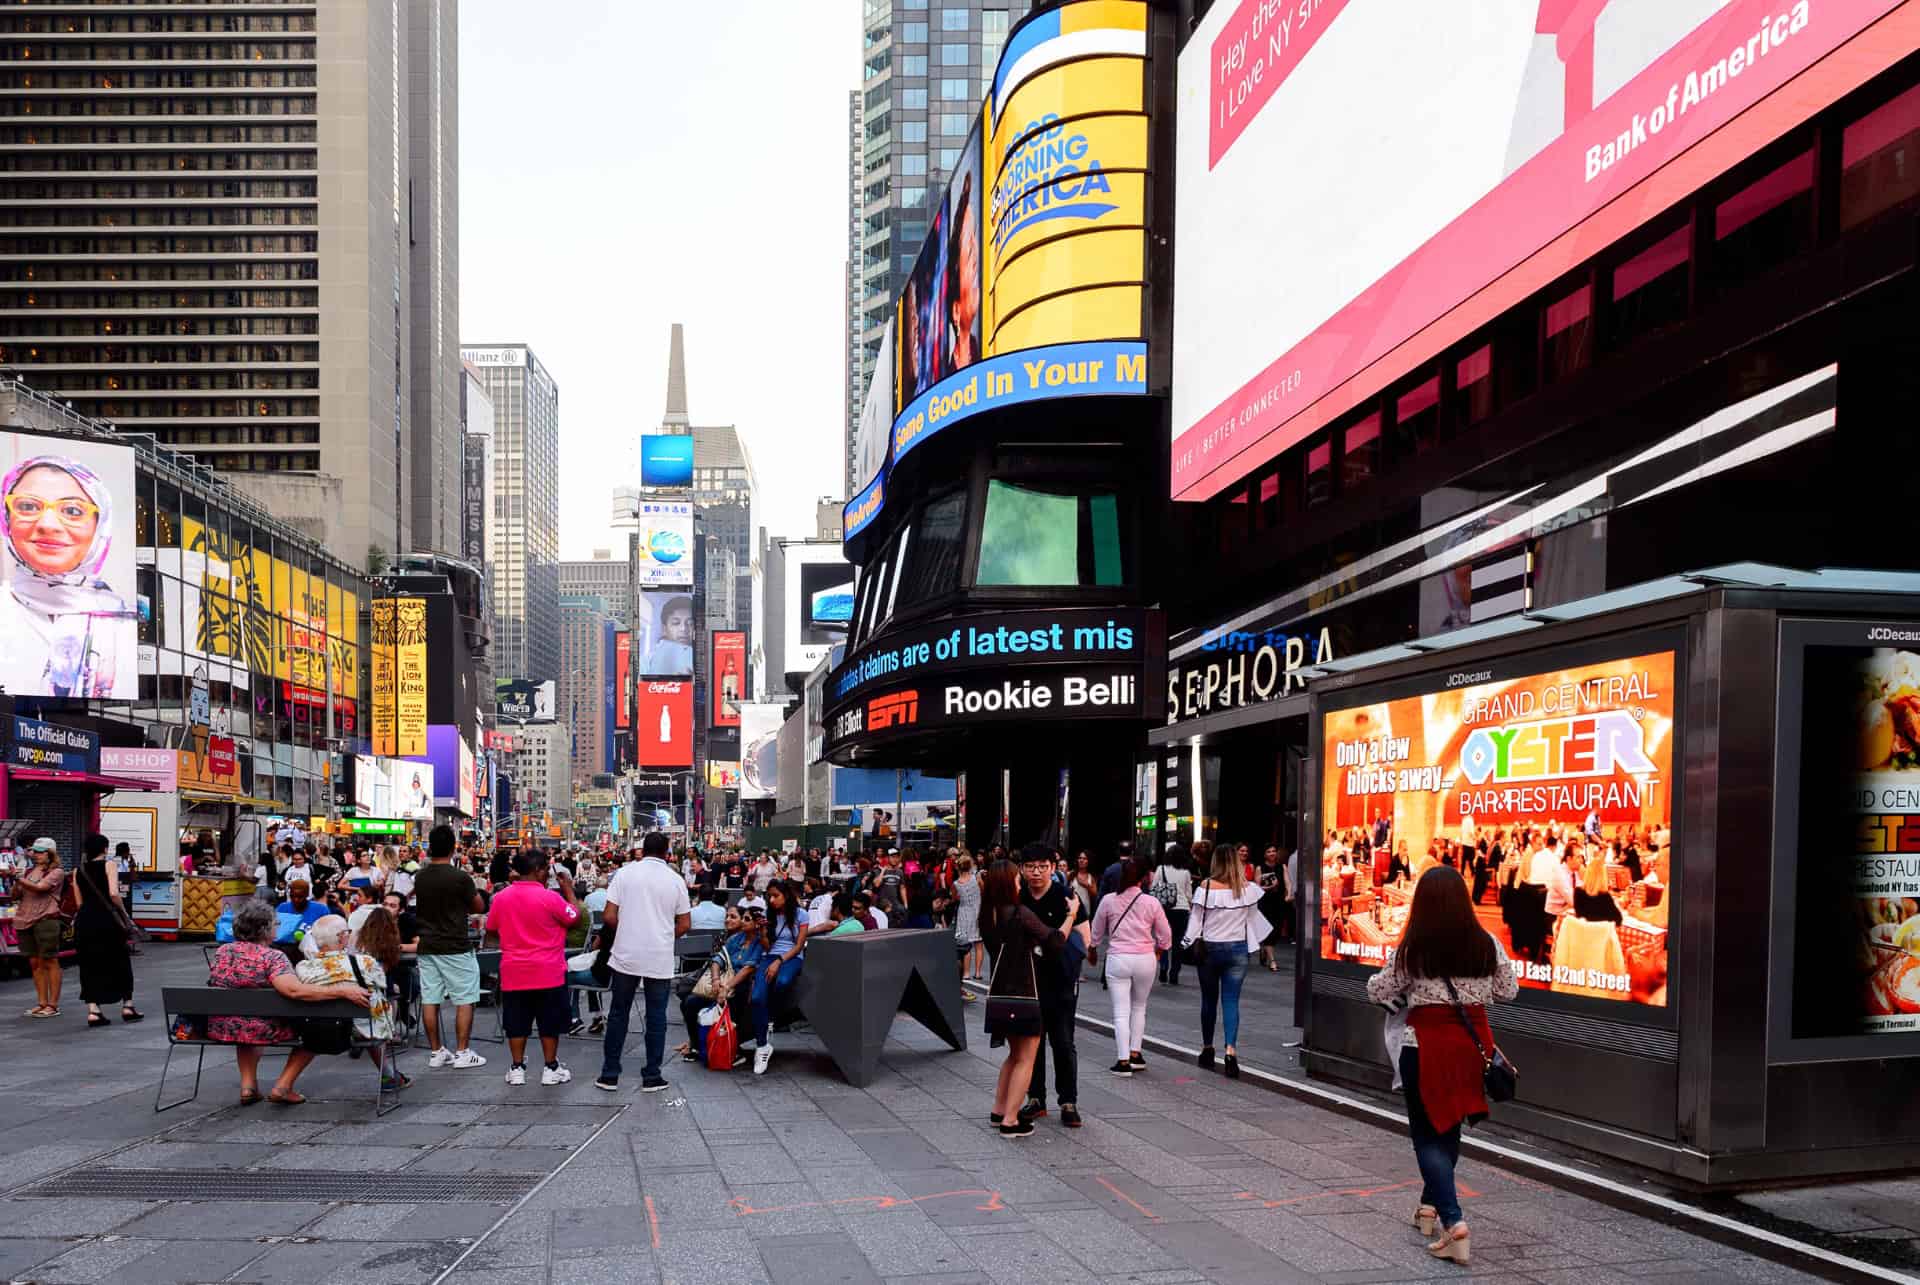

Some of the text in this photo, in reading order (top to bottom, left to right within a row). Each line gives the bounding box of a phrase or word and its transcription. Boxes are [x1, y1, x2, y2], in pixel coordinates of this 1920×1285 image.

[1219, 32, 1248, 86] Hey
[1219, 100, 1225, 129] I
[1229, 58, 1264, 118] Love
[1268, 8, 1294, 67] NY
[1585, 0, 1809, 183] Bank of America
[928, 376, 978, 423] Good
[986, 370, 1014, 399] In
[1023, 359, 1104, 389] Your
[1176, 448, 1194, 474] LIFE
[1201, 416, 1237, 455] BETTER
[1239, 369, 1303, 428] CONNECTED
[471, 456, 487, 532] TIMES
[302, 592, 326, 617] THE
[865, 650, 899, 681] claims
[902, 641, 930, 669] are
[936, 629, 960, 660] of
[968, 622, 1064, 657] latest
[1073, 620, 1133, 651] mis
[400, 681, 424, 694] KING
[402, 670, 422, 681] LION
[1166, 626, 1333, 726] SEPHORA
[1446, 670, 1492, 687] JCDecaux
[867, 690, 919, 731] ESPN
[945, 675, 1135, 715] Rookie Belli
[1463, 672, 1659, 725] GRAND CENTRAL
[18, 721, 90, 750] The Official Guide
[1336, 734, 1411, 768] Only a few
[1460, 708, 1660, 784] OYSTER
[18, 745, 63, 764] nycgo.com
[124, 754, 170, 768] SHOP
[1346, 766, 1397, 796] blocks
[1857, 859, 1920, 878] ESTAU
[1336, 938, 1361, 956] Lower
[1526, 961, 1552, 982] East
[1552, 965, 1586, 986] 42nd
[1588, 968, 1632, 993] Street
